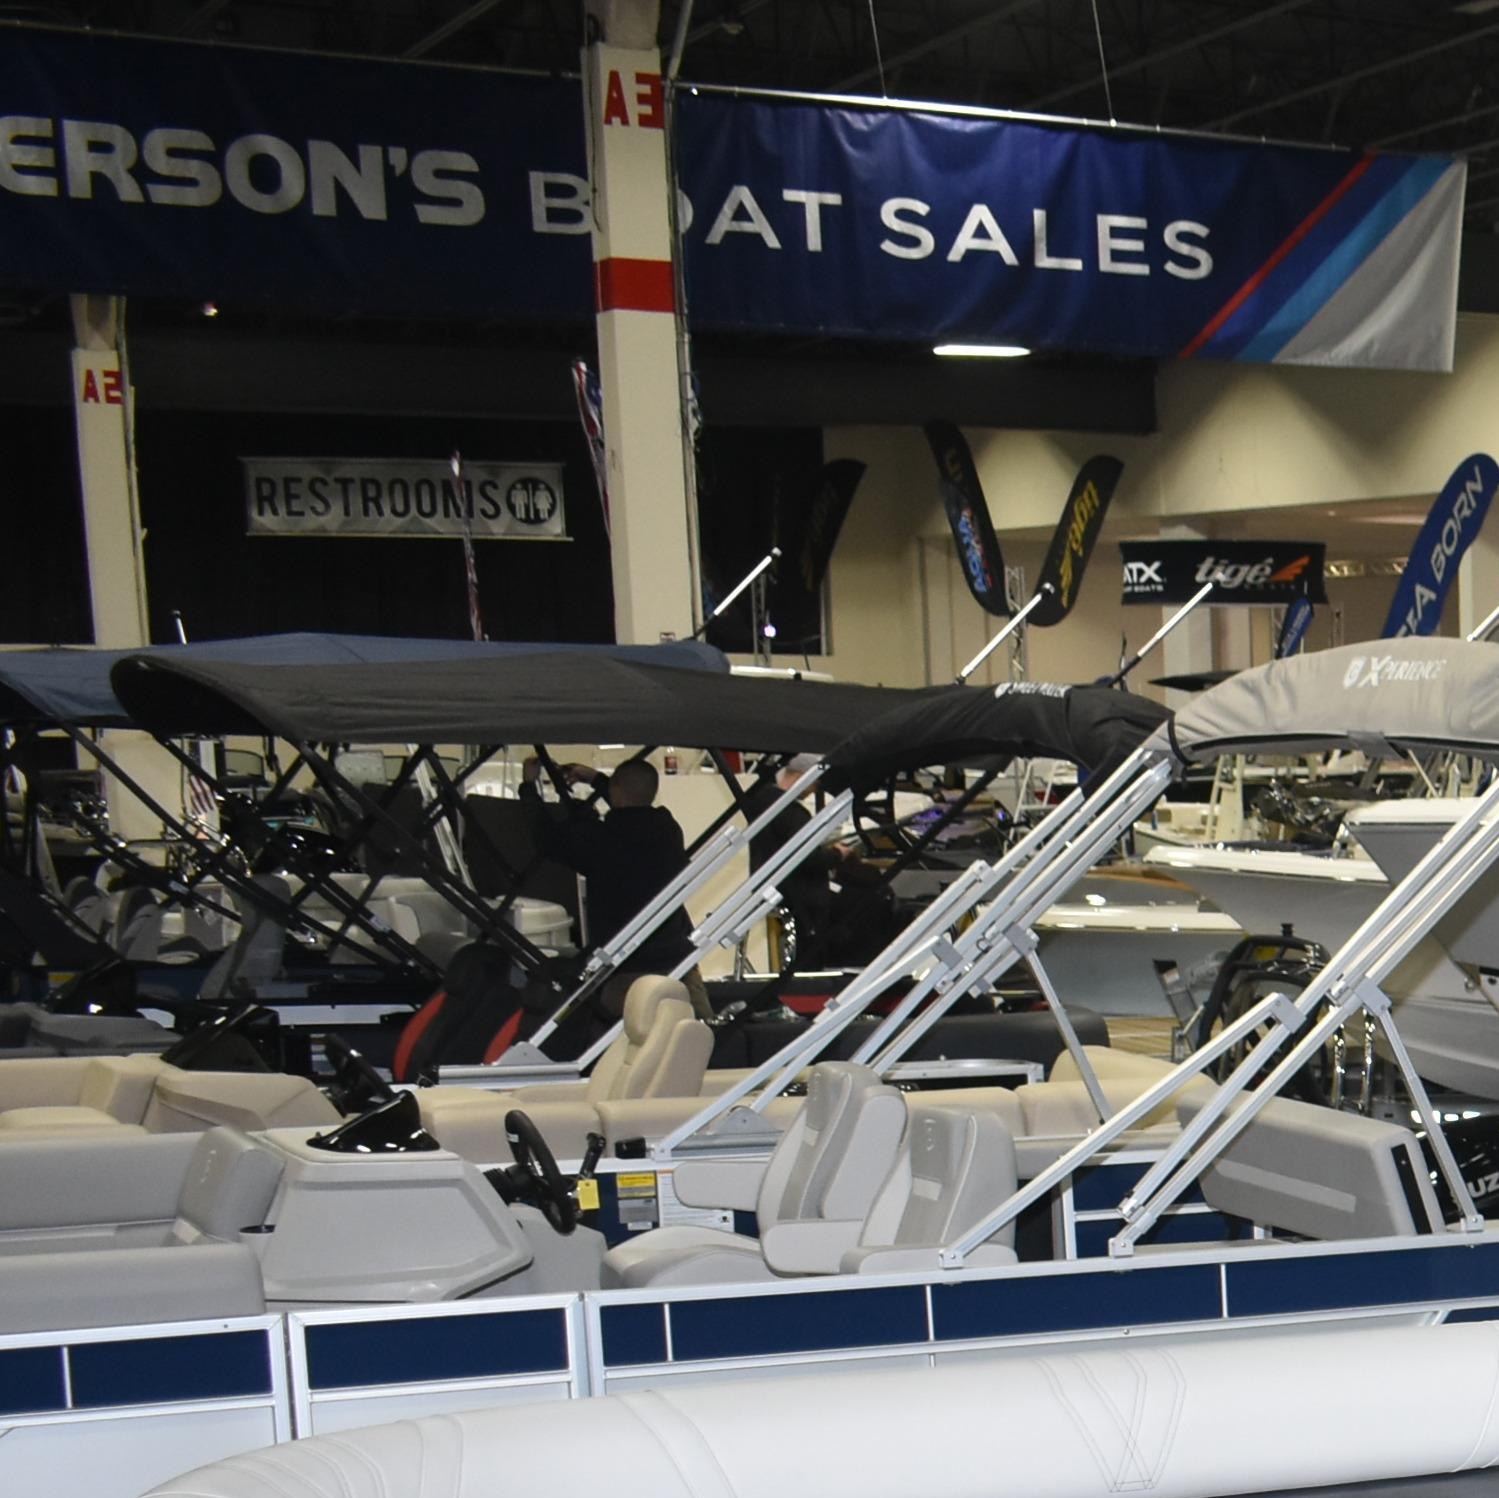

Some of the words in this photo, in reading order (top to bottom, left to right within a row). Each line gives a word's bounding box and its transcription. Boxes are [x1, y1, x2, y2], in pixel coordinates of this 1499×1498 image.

[527, 171, 842, 253] BAT
[879, 196, 1214, 281] SALES
[254, 475, 502, 521] RESTROOMS
[1429, 463, 1484, 585] BORN
